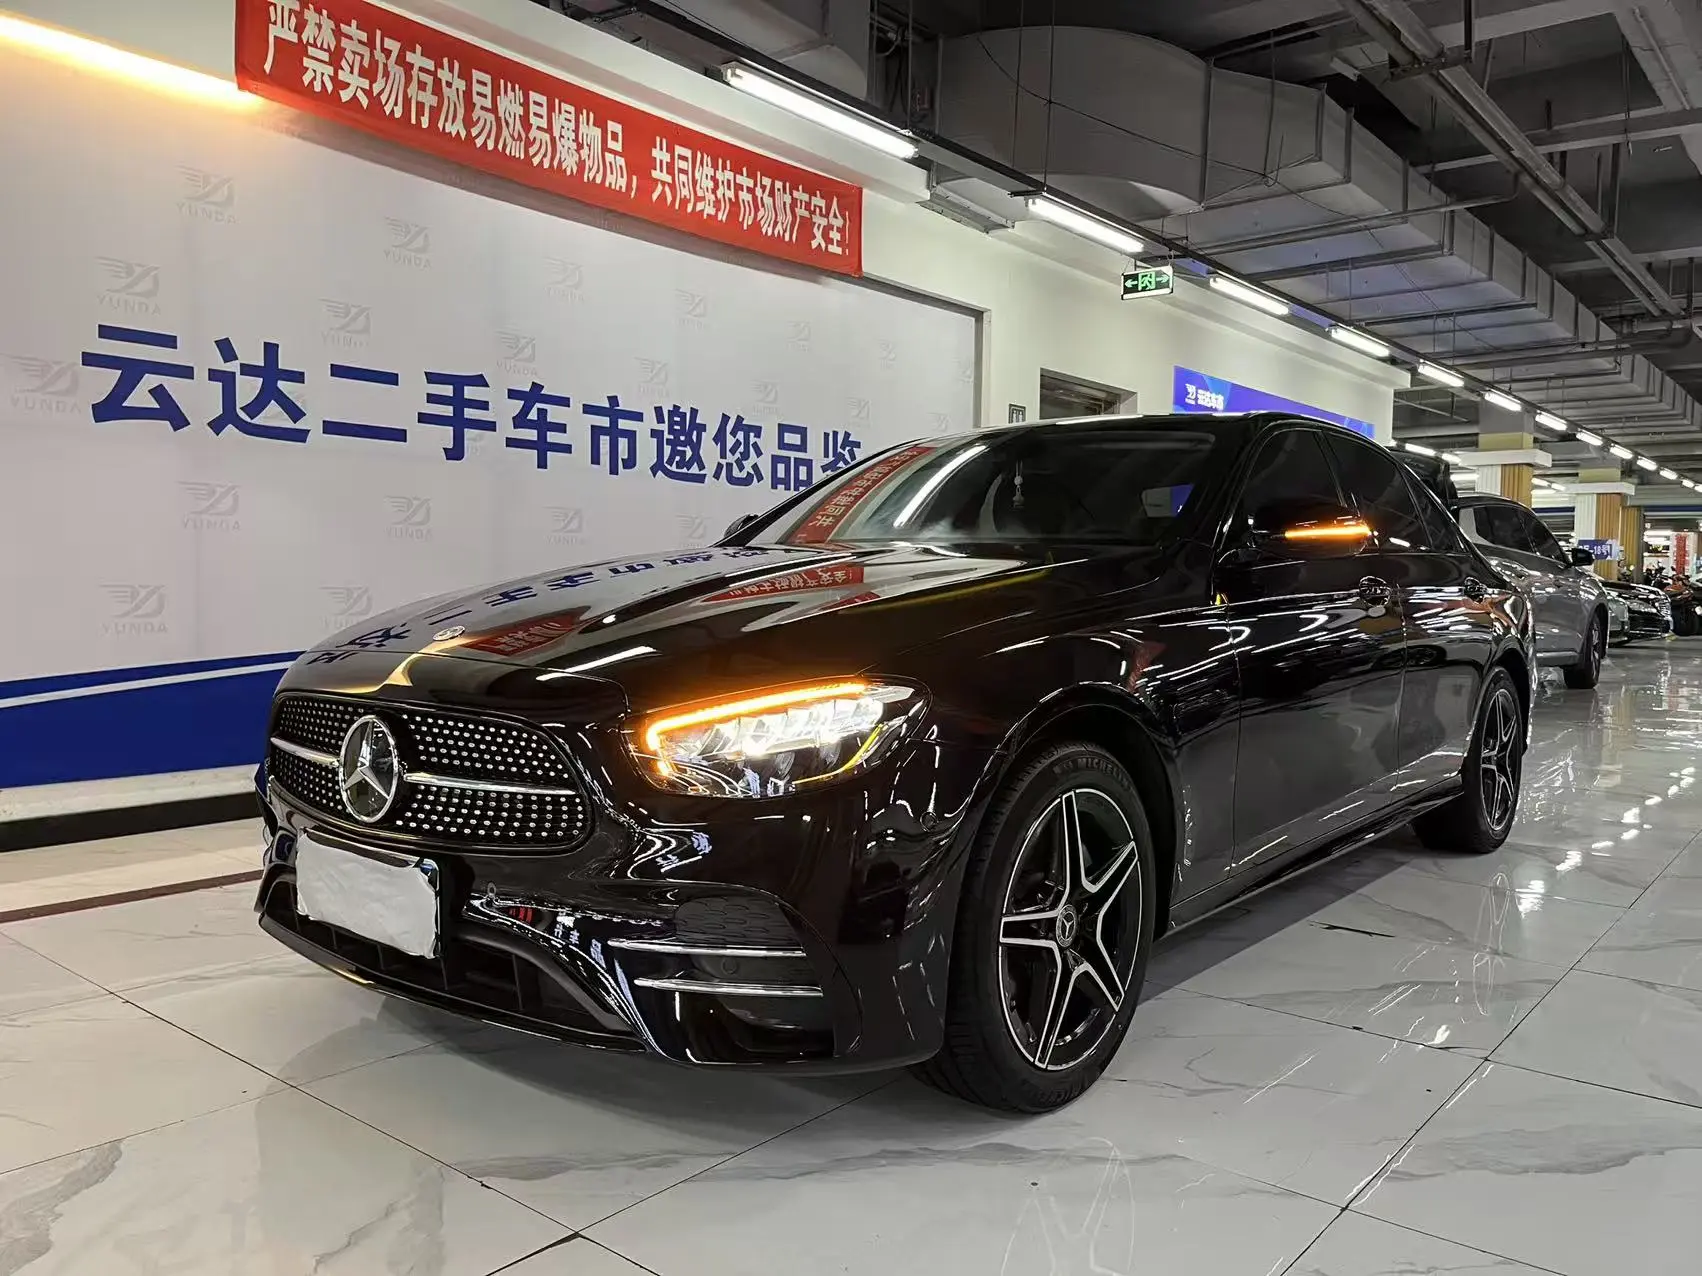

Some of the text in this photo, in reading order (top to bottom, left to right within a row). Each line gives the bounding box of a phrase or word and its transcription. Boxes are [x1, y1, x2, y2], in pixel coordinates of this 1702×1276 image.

[97, 294, 161, 315] YUNDA
[10, 395, 82, 415] YUNDA
[101, 622, 169, 636] YUNDA
